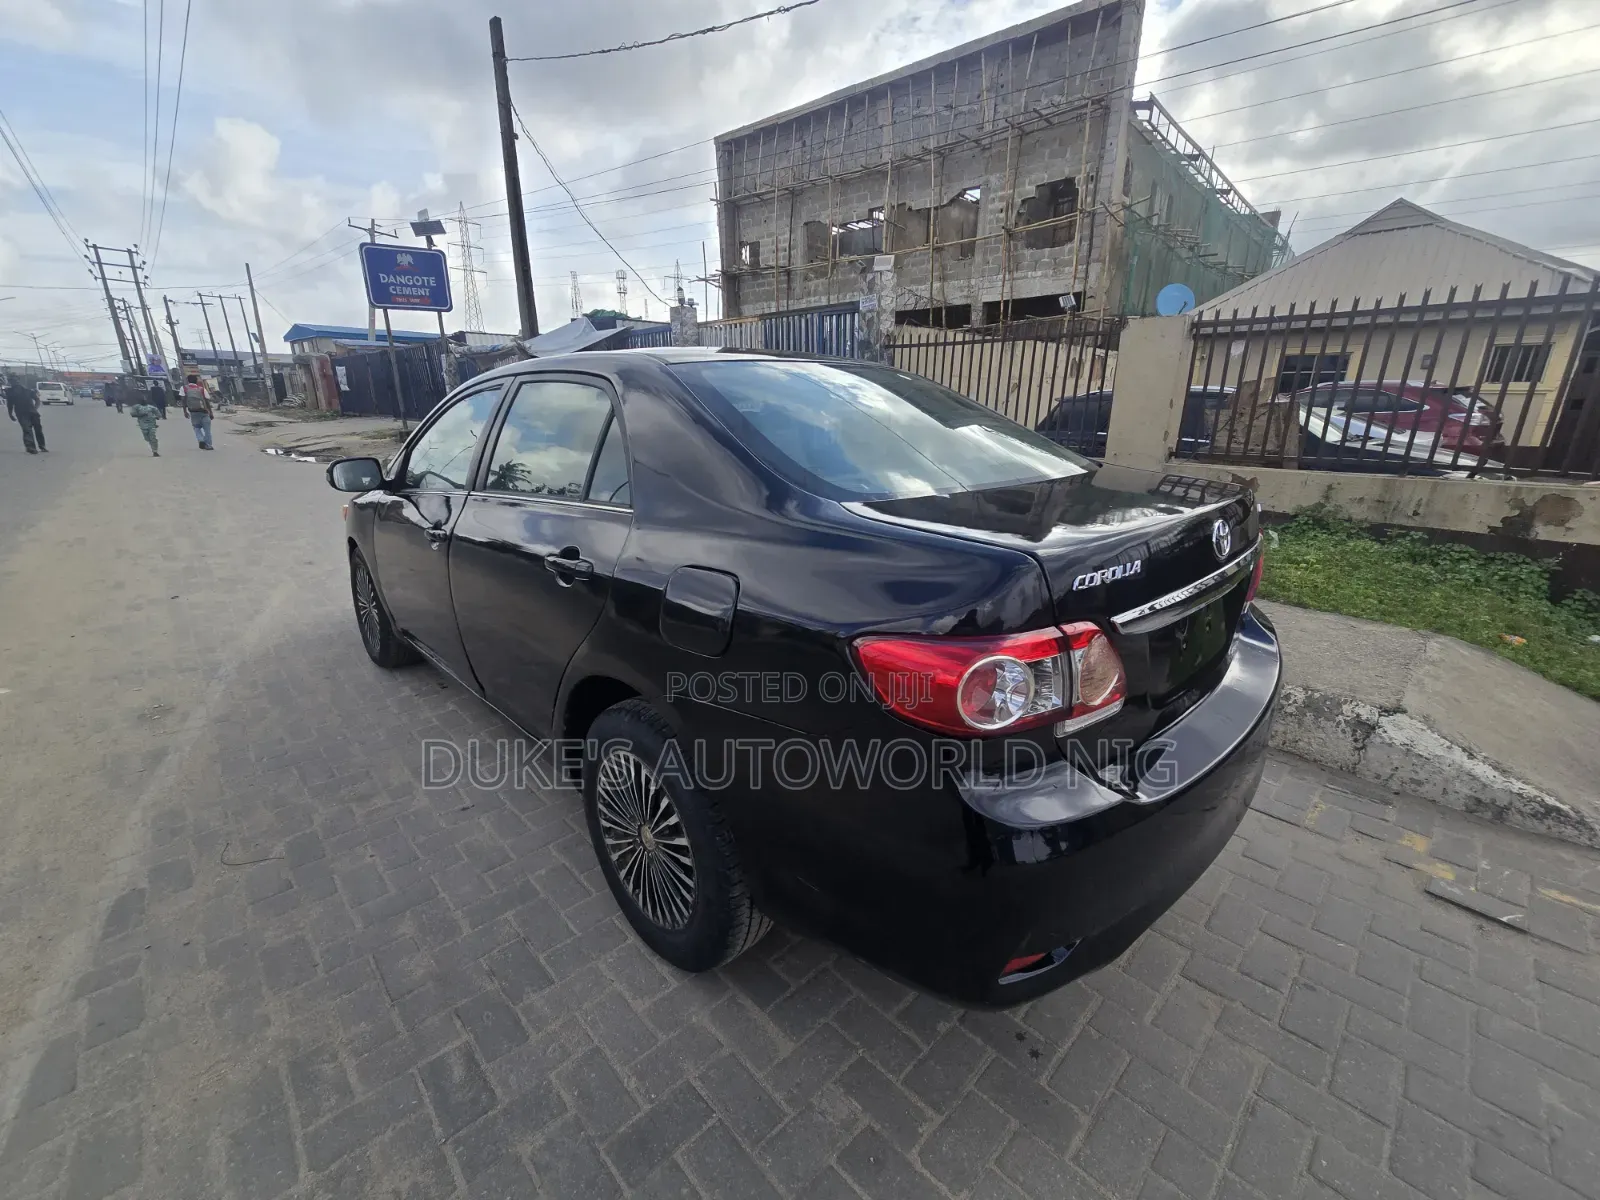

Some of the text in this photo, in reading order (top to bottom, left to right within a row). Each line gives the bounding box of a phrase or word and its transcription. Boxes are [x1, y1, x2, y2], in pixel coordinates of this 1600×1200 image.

[379, 273, 436, 286] DANGOTE
[389, 285, 430, 296] CEMENT
[1072, 559, 1142, 591] COROLLA
